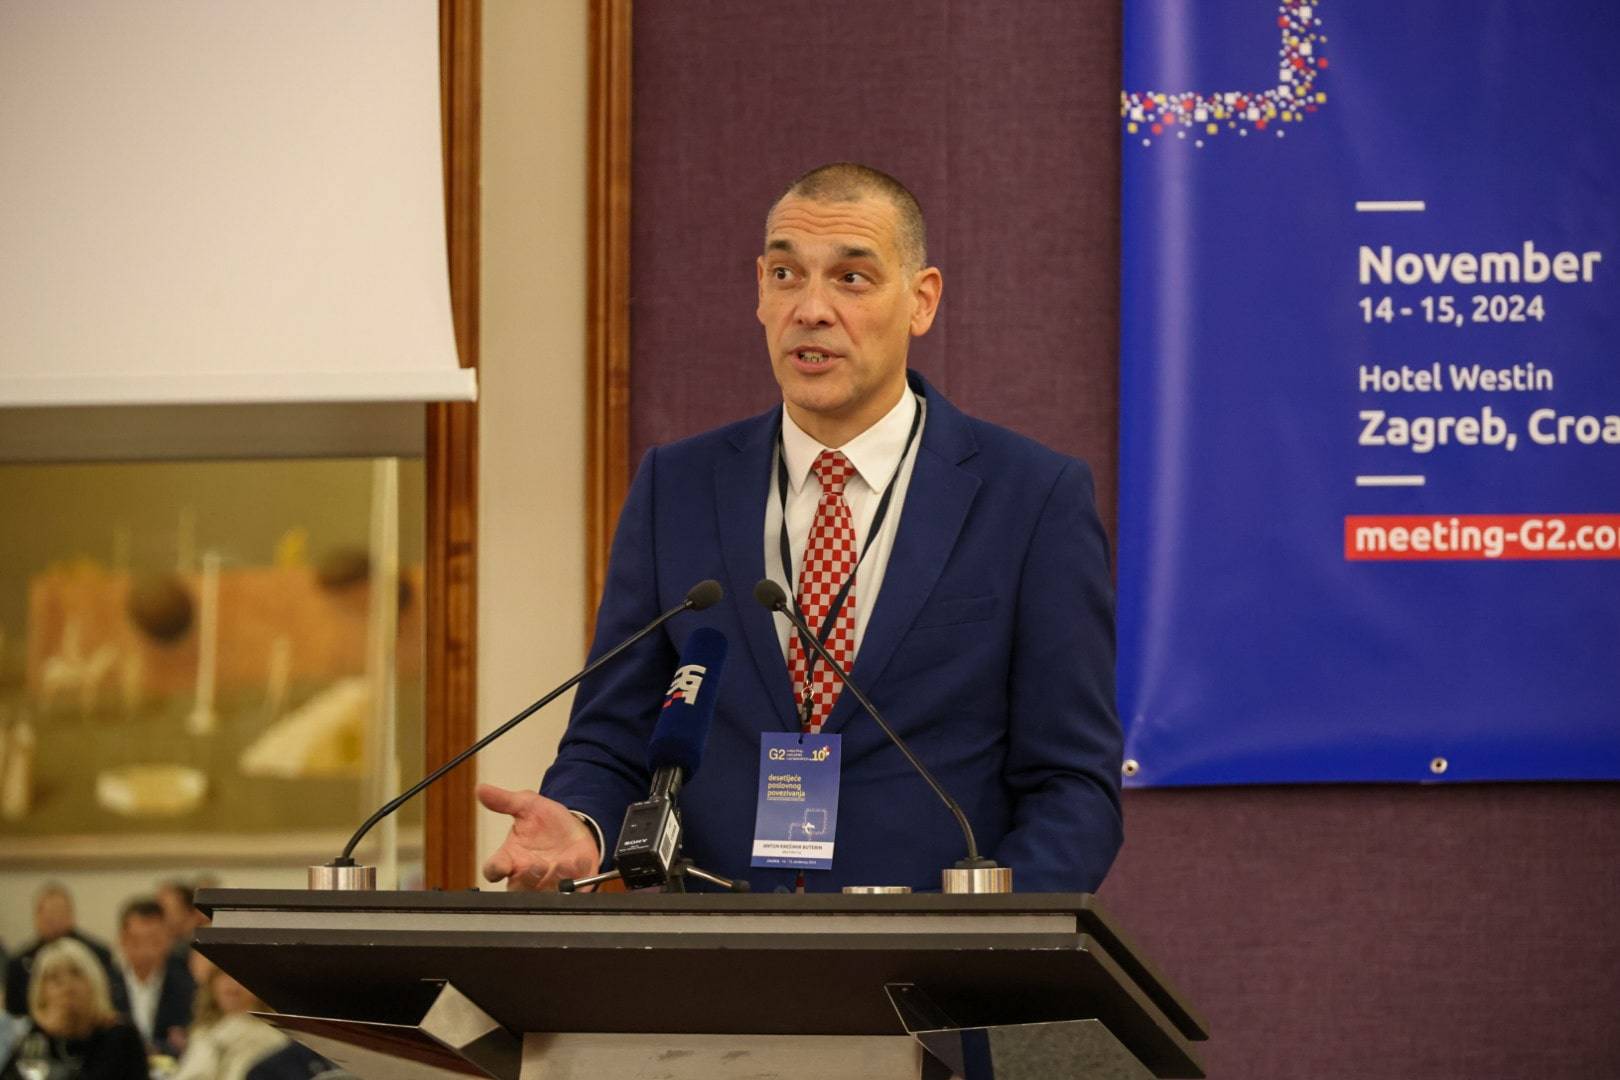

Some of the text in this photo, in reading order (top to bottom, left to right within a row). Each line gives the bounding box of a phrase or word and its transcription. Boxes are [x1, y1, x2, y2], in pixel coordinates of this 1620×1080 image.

[1359, 241, 1602, 285] November
[1359, 296, 1394, 323] 14
[1421, 296, 1464, 327] 15,
[1471, 294, 1545, 323] 2024
[1359, 362, 1553, 392] Hotel Westin
[1358, 406, 1517, 453] Zagreb,
[1355, 517, 1620, 558] meeting-G2.co
[769, 748, 785, 760] G2
[623, 838, 648, 846] SONY
